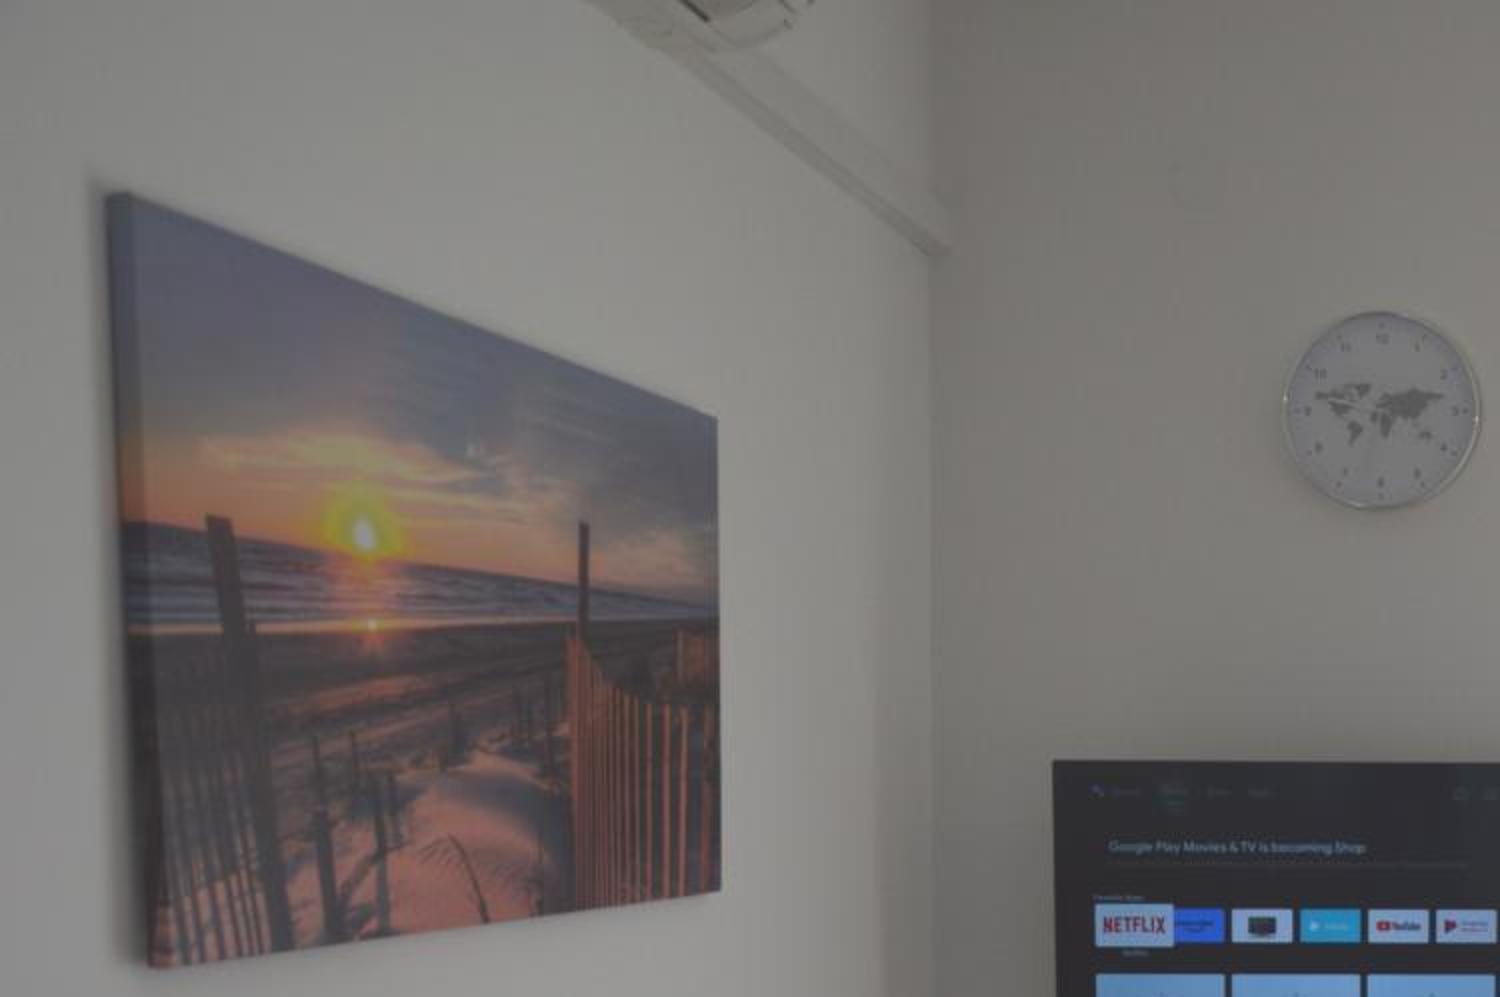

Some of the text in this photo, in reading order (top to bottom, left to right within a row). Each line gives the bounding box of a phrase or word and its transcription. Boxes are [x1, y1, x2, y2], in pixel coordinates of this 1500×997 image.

[1108, 840, 1152, 856] Google
[1156, 840, 1180, 856] Play
[1183, 840, 1226, 854] Movies
[1240, 841, 1257, 854] TV
[1258, 841, 1269, 854] is
[1271, 841, 1333, 857] becoming
[1335, 841, 1367, 856] Shop
[1102, 915, 1167, 934] NETFLIX
